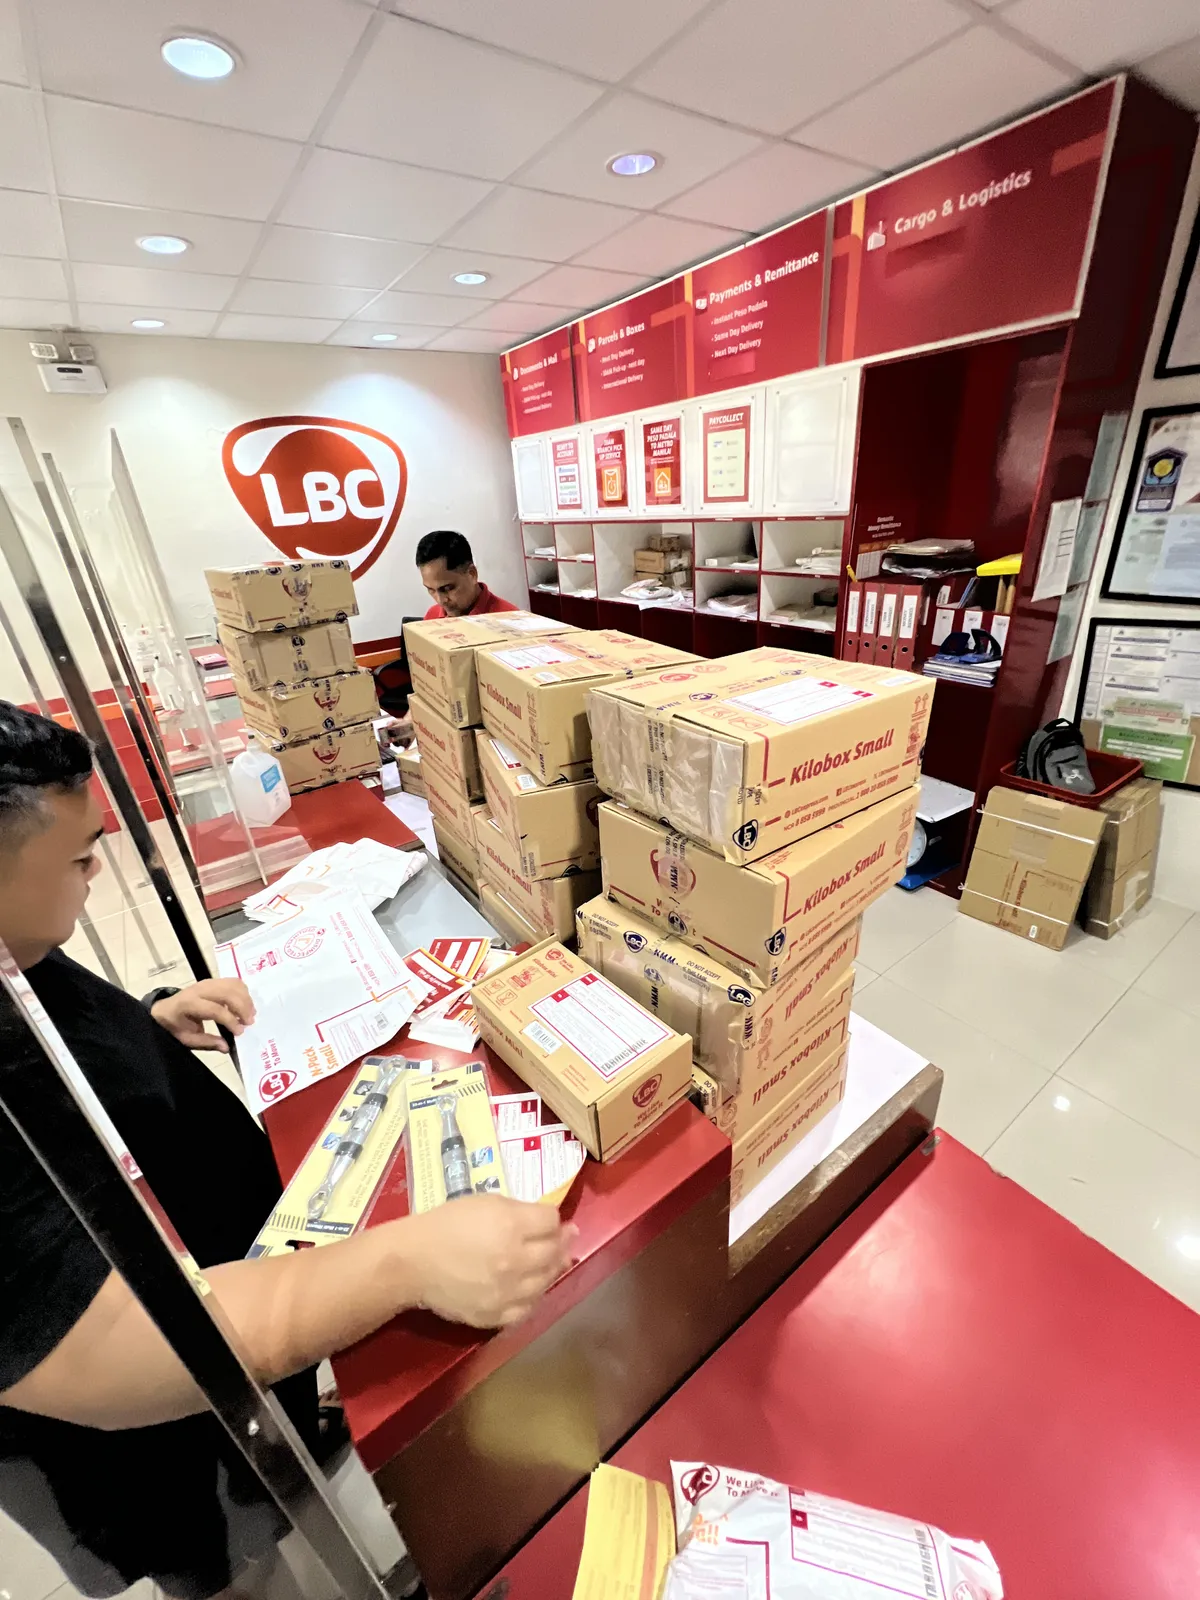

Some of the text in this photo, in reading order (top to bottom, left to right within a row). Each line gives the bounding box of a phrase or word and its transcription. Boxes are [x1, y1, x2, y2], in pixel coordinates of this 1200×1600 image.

[894, 169, 1032, 234] Cargo & Logistics
[709, 251, 819, 305] Payments & Remittance
[713, 299, 768, 325] Instant Peso Padala
[598, 322, 645, 346] Parcels & Boxes
[714, 320, 763, 342] Same Day Delivery
[714, 338, 761, 358] Next Day Delivery
[650, 424, 673, 434] SAME DAY
[709, 412, 744, 425] PAYCOLLECT
[647, 431, 676, 442] PESO PADALA
[658, 440, 673, 448] METRO
[259, 468, 385, 527] LBC
[505, 696, 522, 720] Small
[790, 728, 895, 786] Kilobox Small
[743, 825, 752, 848] LBC
[486, 847, 511, 875] Kilobox
[511, 868, 533, 896] Small
[803, 869, 852, 915] Kilobox
[853, 840, 886, 878] Small
[651, 905, 661, 916] To
[627, 934, 642, 946] LBC
[773, 933, 781, 952] LBC
[687, 960, 721, 980] DO NOT ACCEPT
[785, 938, 850, 1021] Kilobox Small
[731, 989, 751, 1007] LBC
[270, 1043, 280, 1058] Move
[319, 1044, 340, 1071] Small
[505, 1035, 524, 1059] Mini
[261, 1048, 272, 1071] We Lik
[274, 1057, 281, 1067] To
[302, 1045, 324, 1078] N-Pack
[752, 1025, 832, 1106] Kilobox Small
[269, 1073, 286, 1095] LBC
[637, 1081, 658, 1103] LBC
[757, 1088, 830, 1168] Kilobox Small
[726, 1476, 741, 1486] We
[727, 1487, 738, 1497] To
